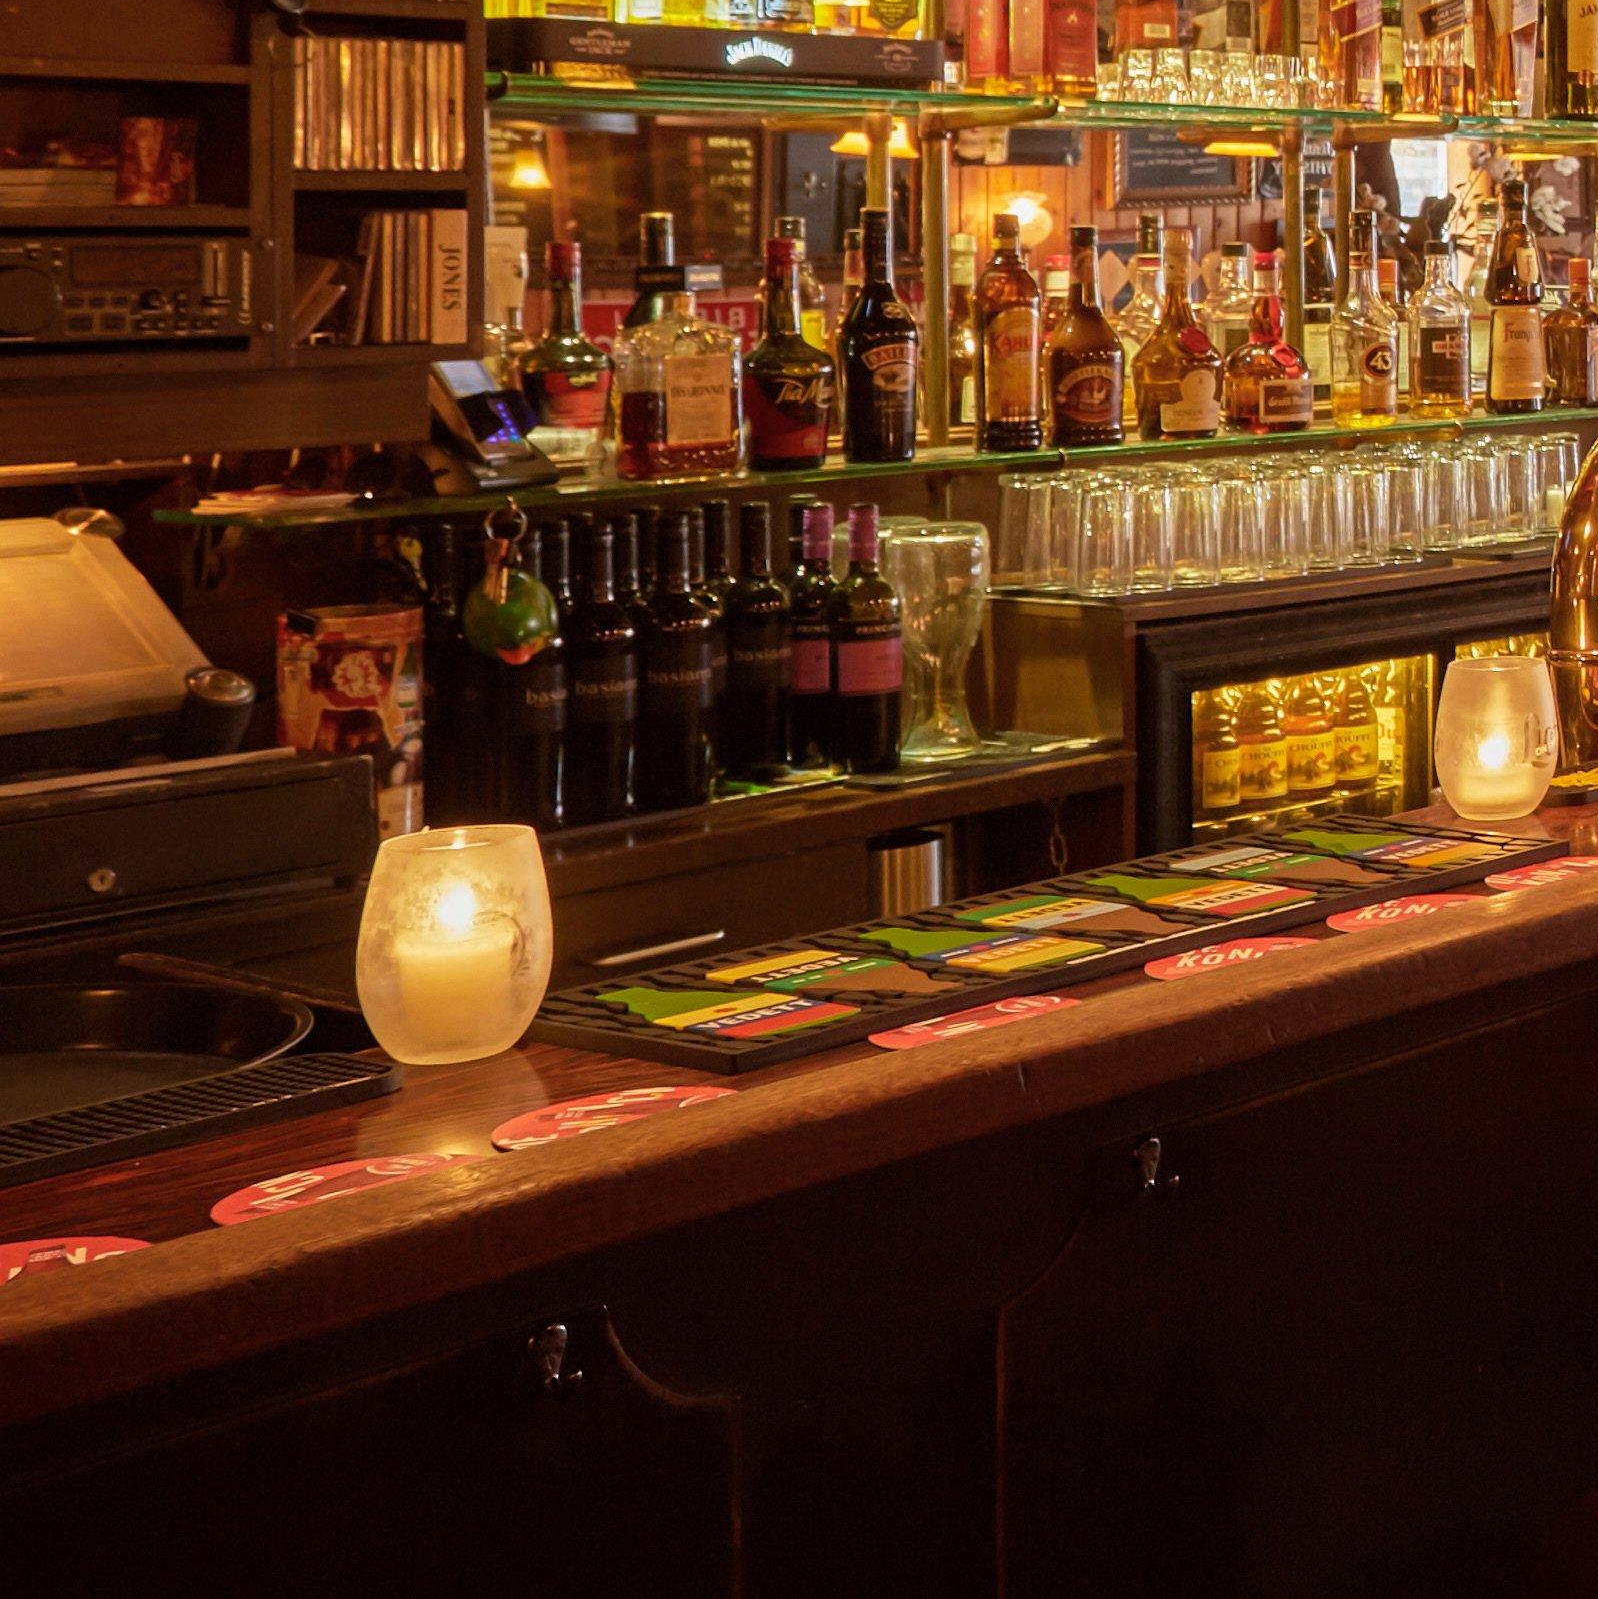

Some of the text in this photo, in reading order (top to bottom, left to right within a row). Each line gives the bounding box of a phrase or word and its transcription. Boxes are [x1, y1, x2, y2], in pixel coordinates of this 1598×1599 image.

[439, 243, 461, 311] JONES
[1369, 350, 1392, 370] 43
[1189, 883, 1273, 909] VEDETT
[1000, 901, 1091, 925] VEDETT
[956, 936, 1062, 965] VEDETT
[751, 955, 859, 984] VEDETT
[696, 999, 813, 1030] VEDETT
